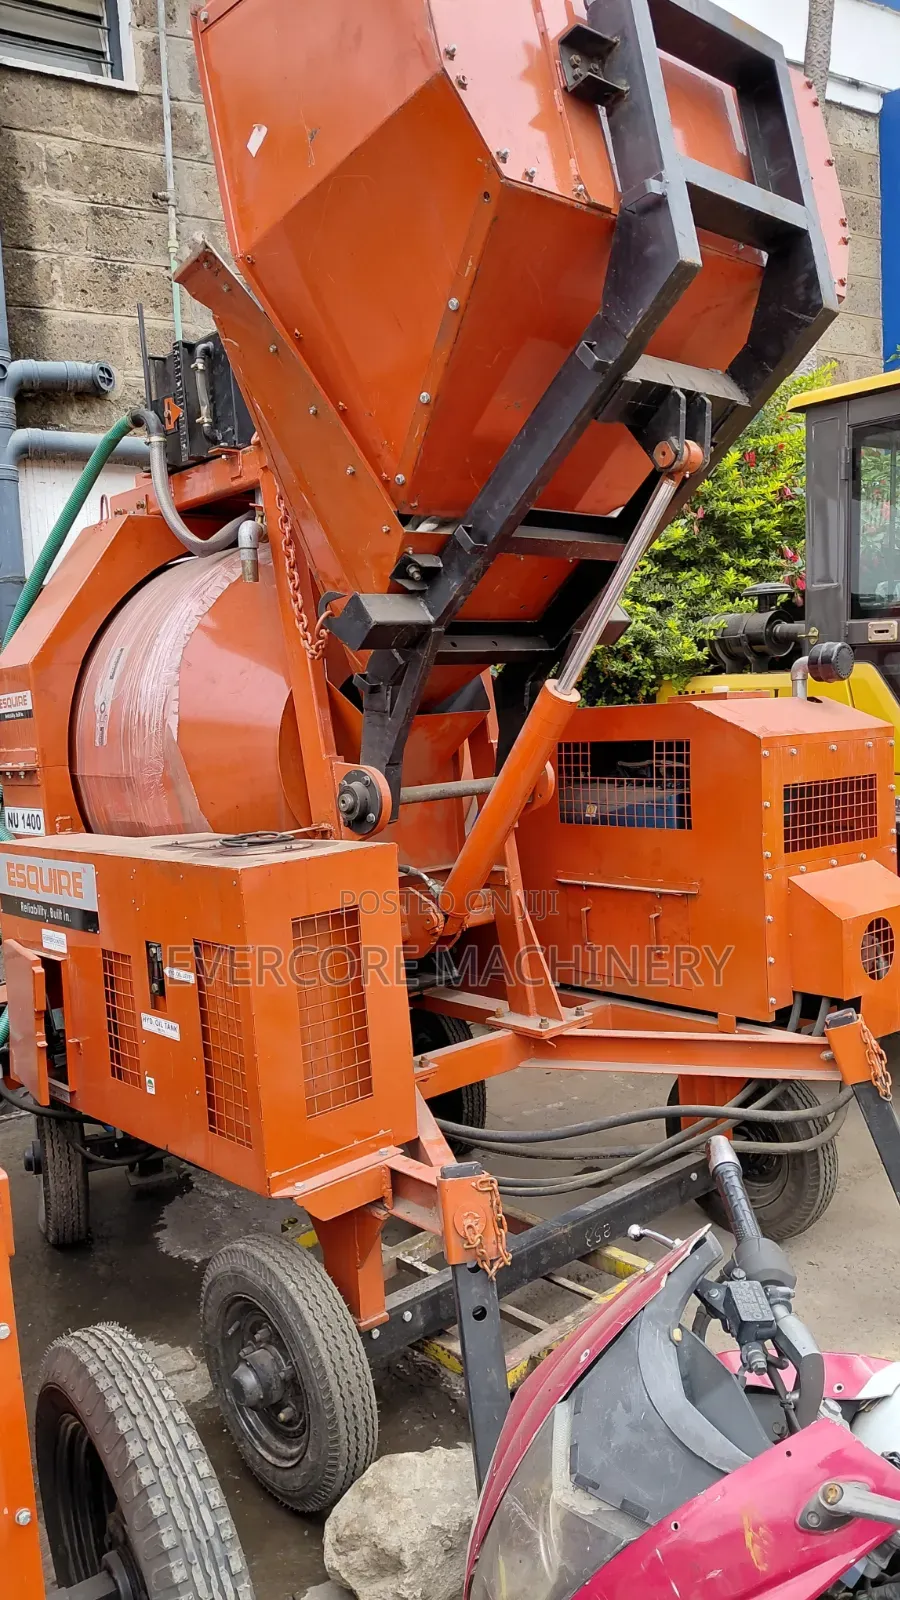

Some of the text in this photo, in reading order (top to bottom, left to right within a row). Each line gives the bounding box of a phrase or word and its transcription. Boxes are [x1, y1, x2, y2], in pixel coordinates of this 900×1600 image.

[0, 694, 27, 710] ESQUIRE
[8, 812, 41, 831] NU 1400
[6, 862, 84, 899] ESQUIRE
[164, 1022, 177, 1033] TANK
